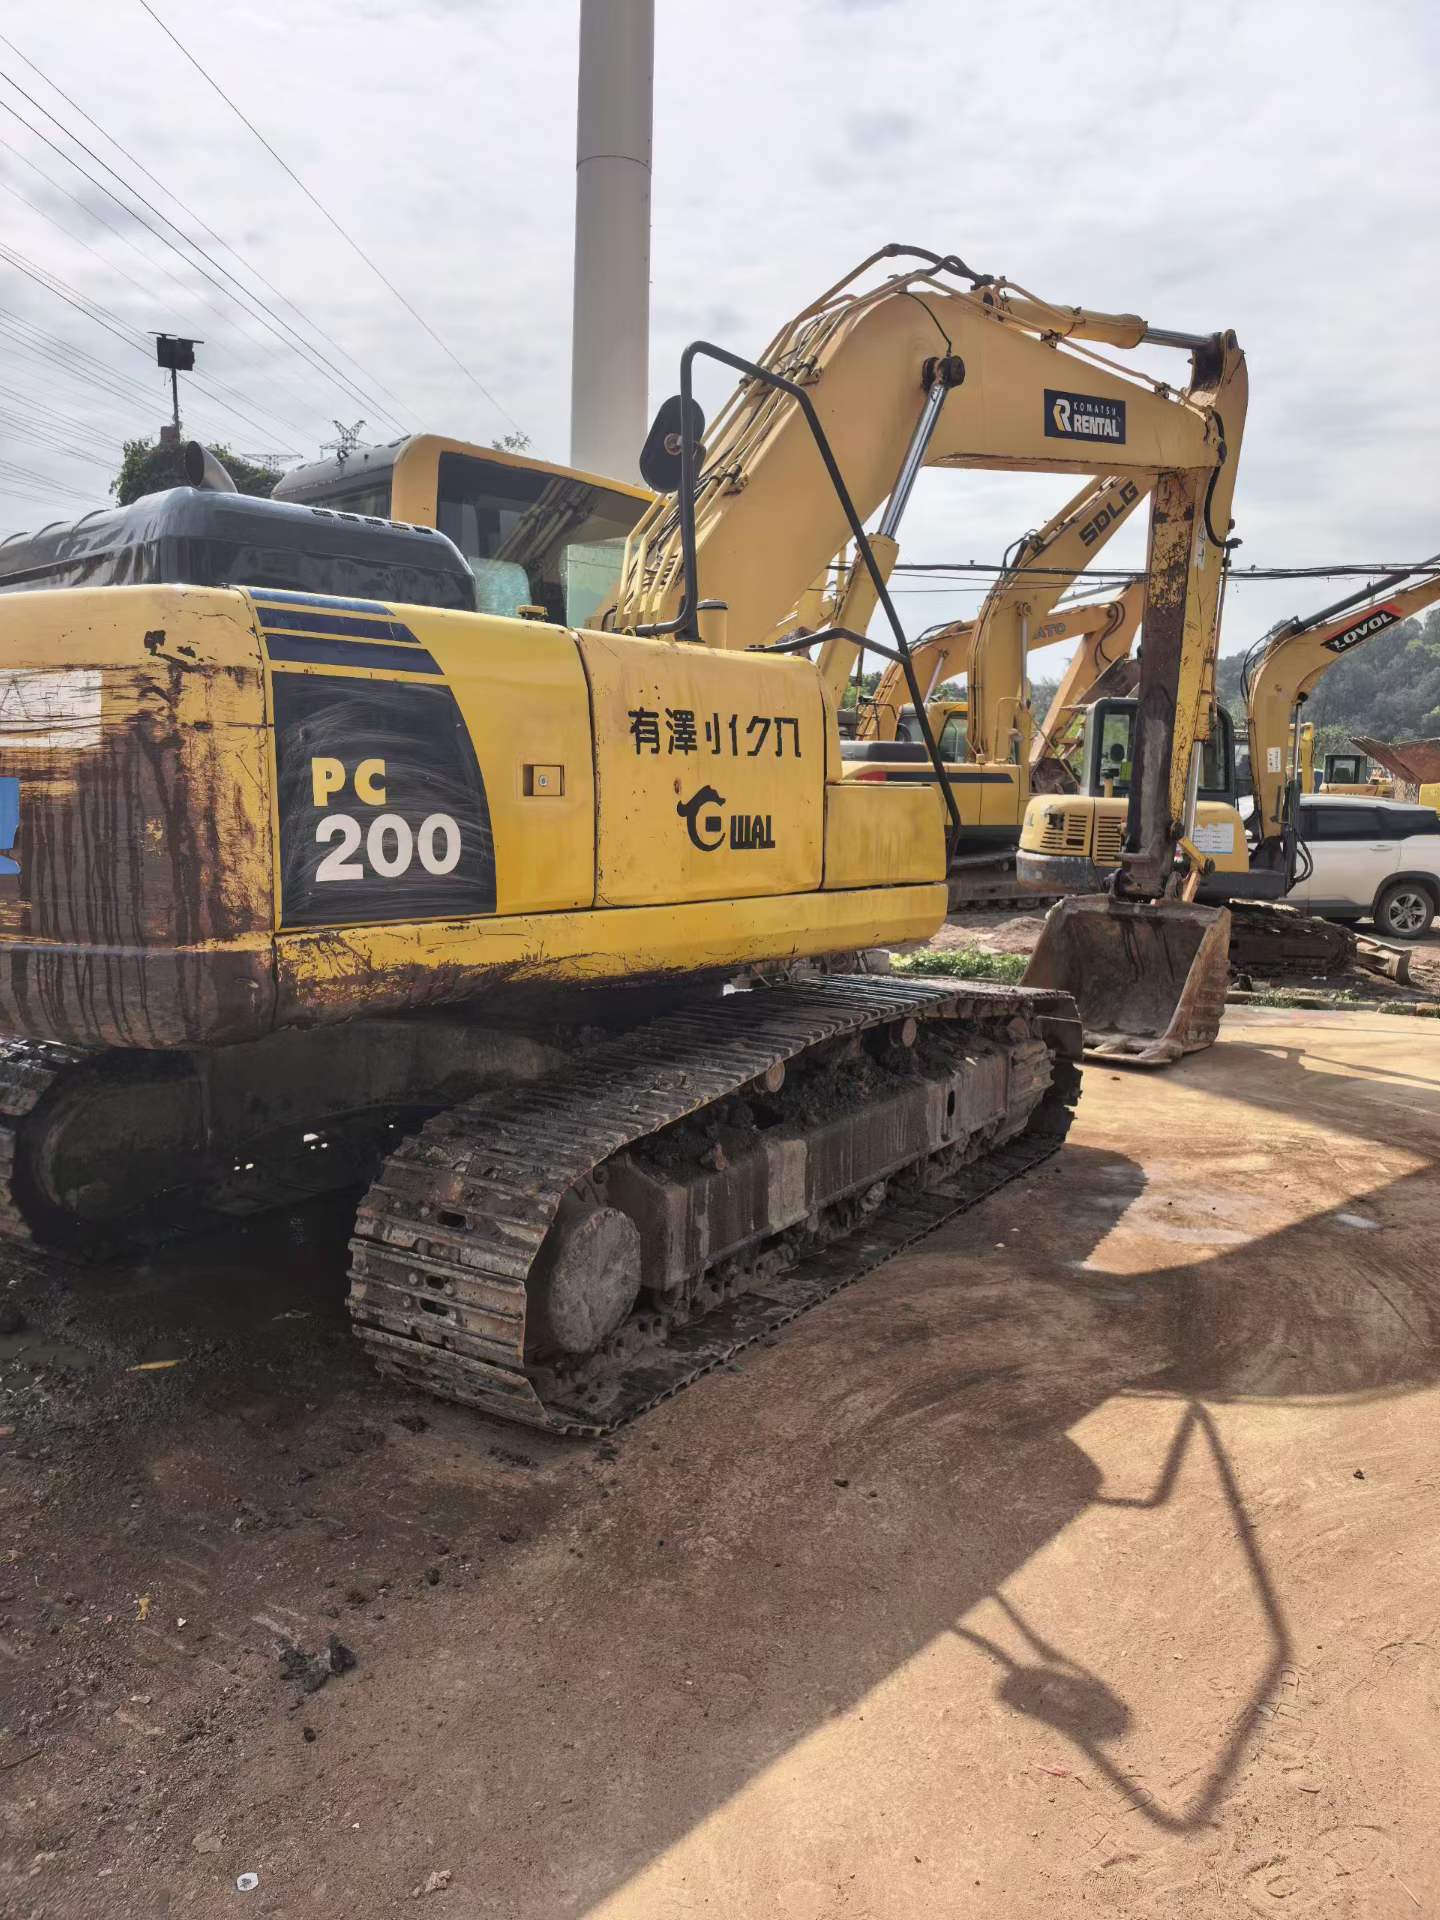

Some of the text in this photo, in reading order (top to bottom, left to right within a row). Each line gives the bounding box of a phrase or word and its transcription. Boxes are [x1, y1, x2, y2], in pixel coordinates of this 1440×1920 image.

[1073, 401, 1116, 416] KOMATSU
[1073, 414, 1120, 437] RENTAL
[1079, 480, 1140, 547] SDLG
[1332, 613, 1393, 649] LOVOL
[311, 757, 387, 807] PC
[315, 813, 462, 883] 200
